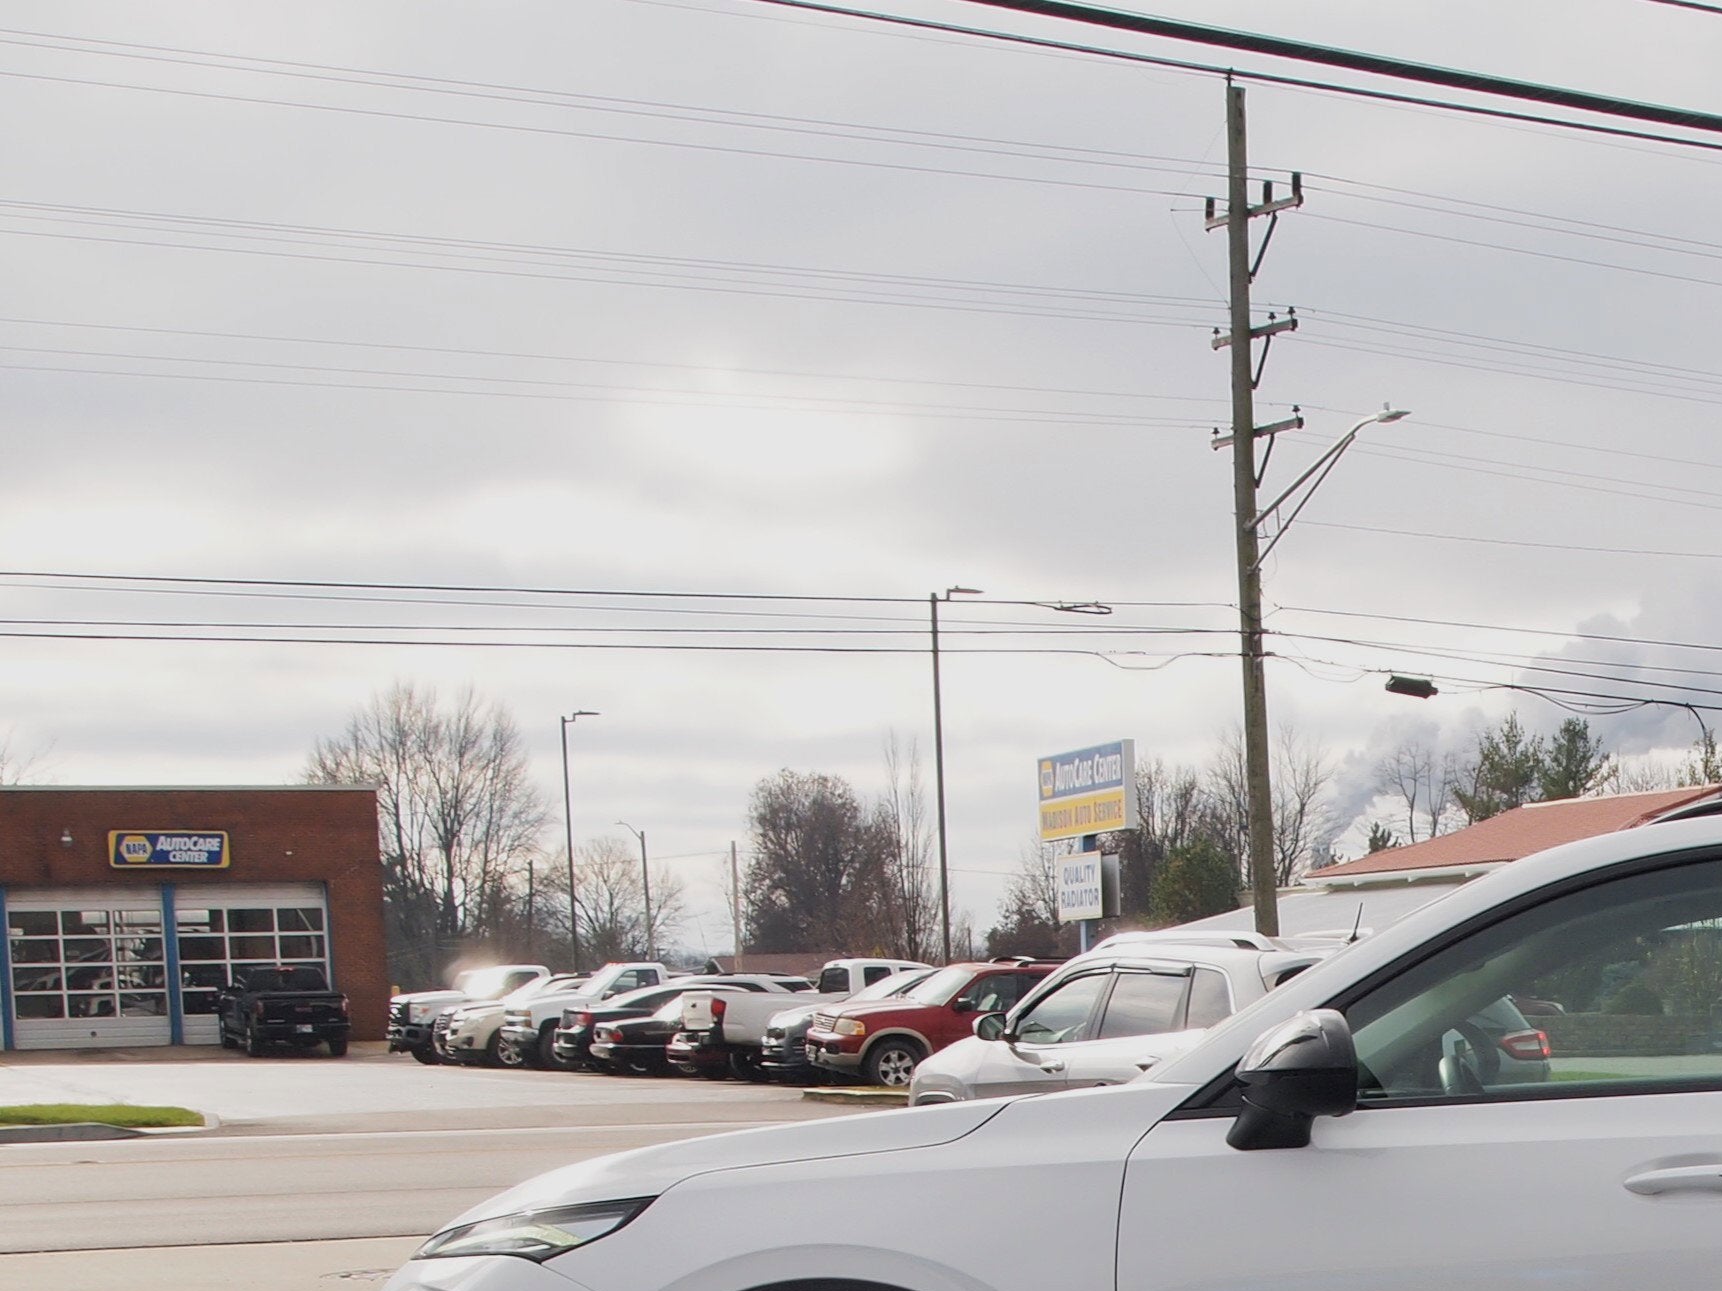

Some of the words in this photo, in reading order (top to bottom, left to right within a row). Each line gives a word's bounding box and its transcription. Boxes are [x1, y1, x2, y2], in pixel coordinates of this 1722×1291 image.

[125, 842, 148, 855] NAPA
[168, 851, 209, 863] CENTER
[1063, 864, 1096, 885] QUALITY
[1061, 888, 1100, 909] RADIATOR
